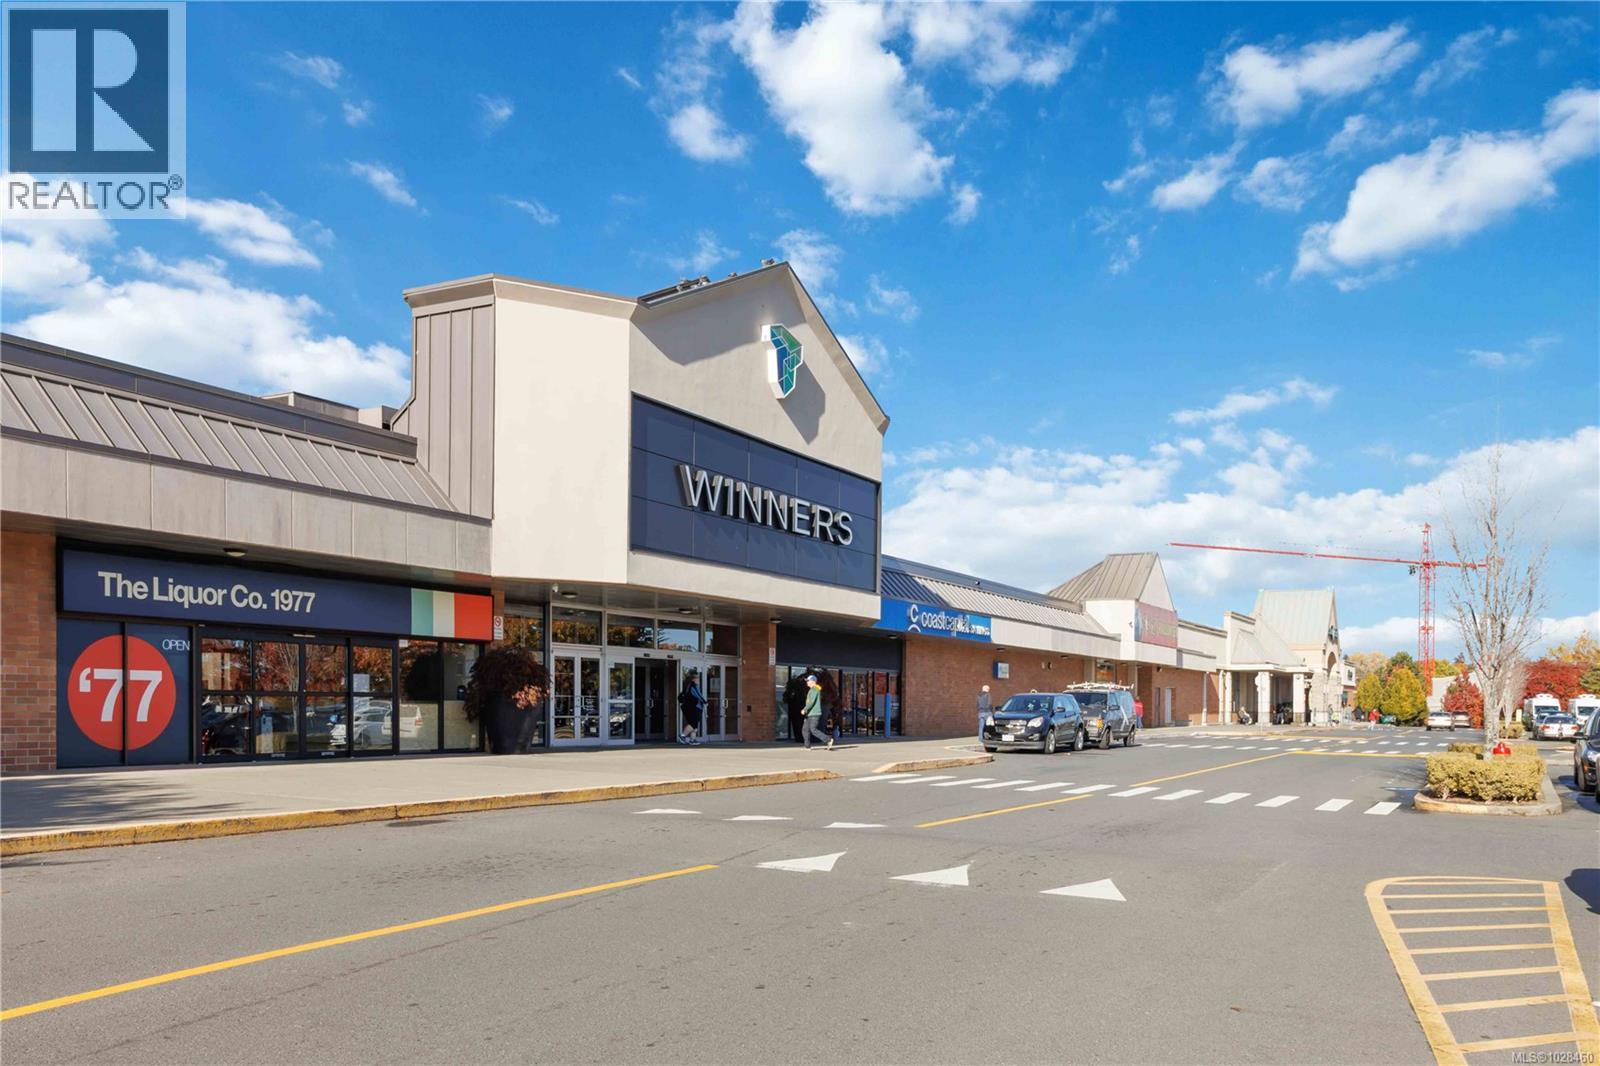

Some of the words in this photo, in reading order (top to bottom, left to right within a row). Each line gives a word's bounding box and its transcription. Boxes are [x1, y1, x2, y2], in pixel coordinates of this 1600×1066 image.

[679, 464, 853, 545] WINNERS
[98, 571, 149, 599] The
[153, 577, 227, 609] Liquor
[231, 584, 267, 609] Co.
[271, 589, 315, 613] 1977
[162, 639, 190, 651] OPEN
